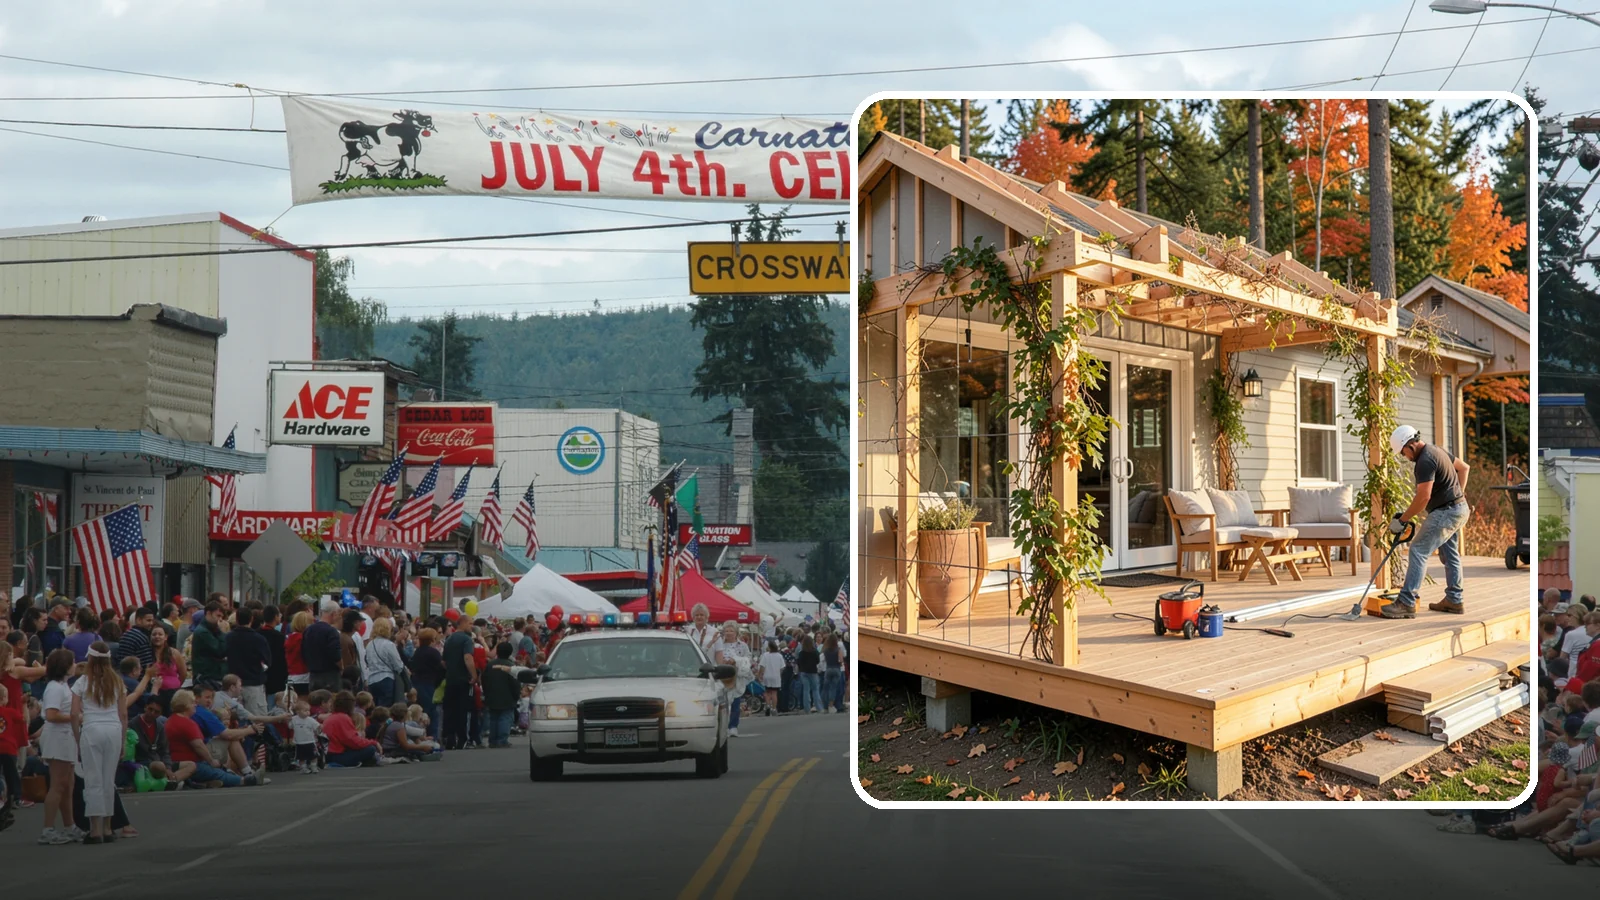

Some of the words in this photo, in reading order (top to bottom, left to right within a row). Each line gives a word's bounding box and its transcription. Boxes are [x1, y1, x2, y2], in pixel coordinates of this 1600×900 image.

[695, 121, 850, 150] Carnat
[481, 141, 605, 193] JULY
[632, 150, 746, 198] 4th.
[697, 254, 850, 280] CROSSWA
[282, 380, 374, 420] ACE
[405, 409, 453, 422] CEDAR
[461, 409, 486, 422] LOG
[283, 421, 371, 437] Hardware
[416, 428, 477, 447] Coca-Cola
[353, 467, 389, 479] Simpl
[96, 485, 124, 495] Vincent
[126, 486, 136, 495] de
[138, 486, 155, 496] Paul
[688, 526, 741, 535] CRNATION
[699, 535, 730, 543] GLASS
